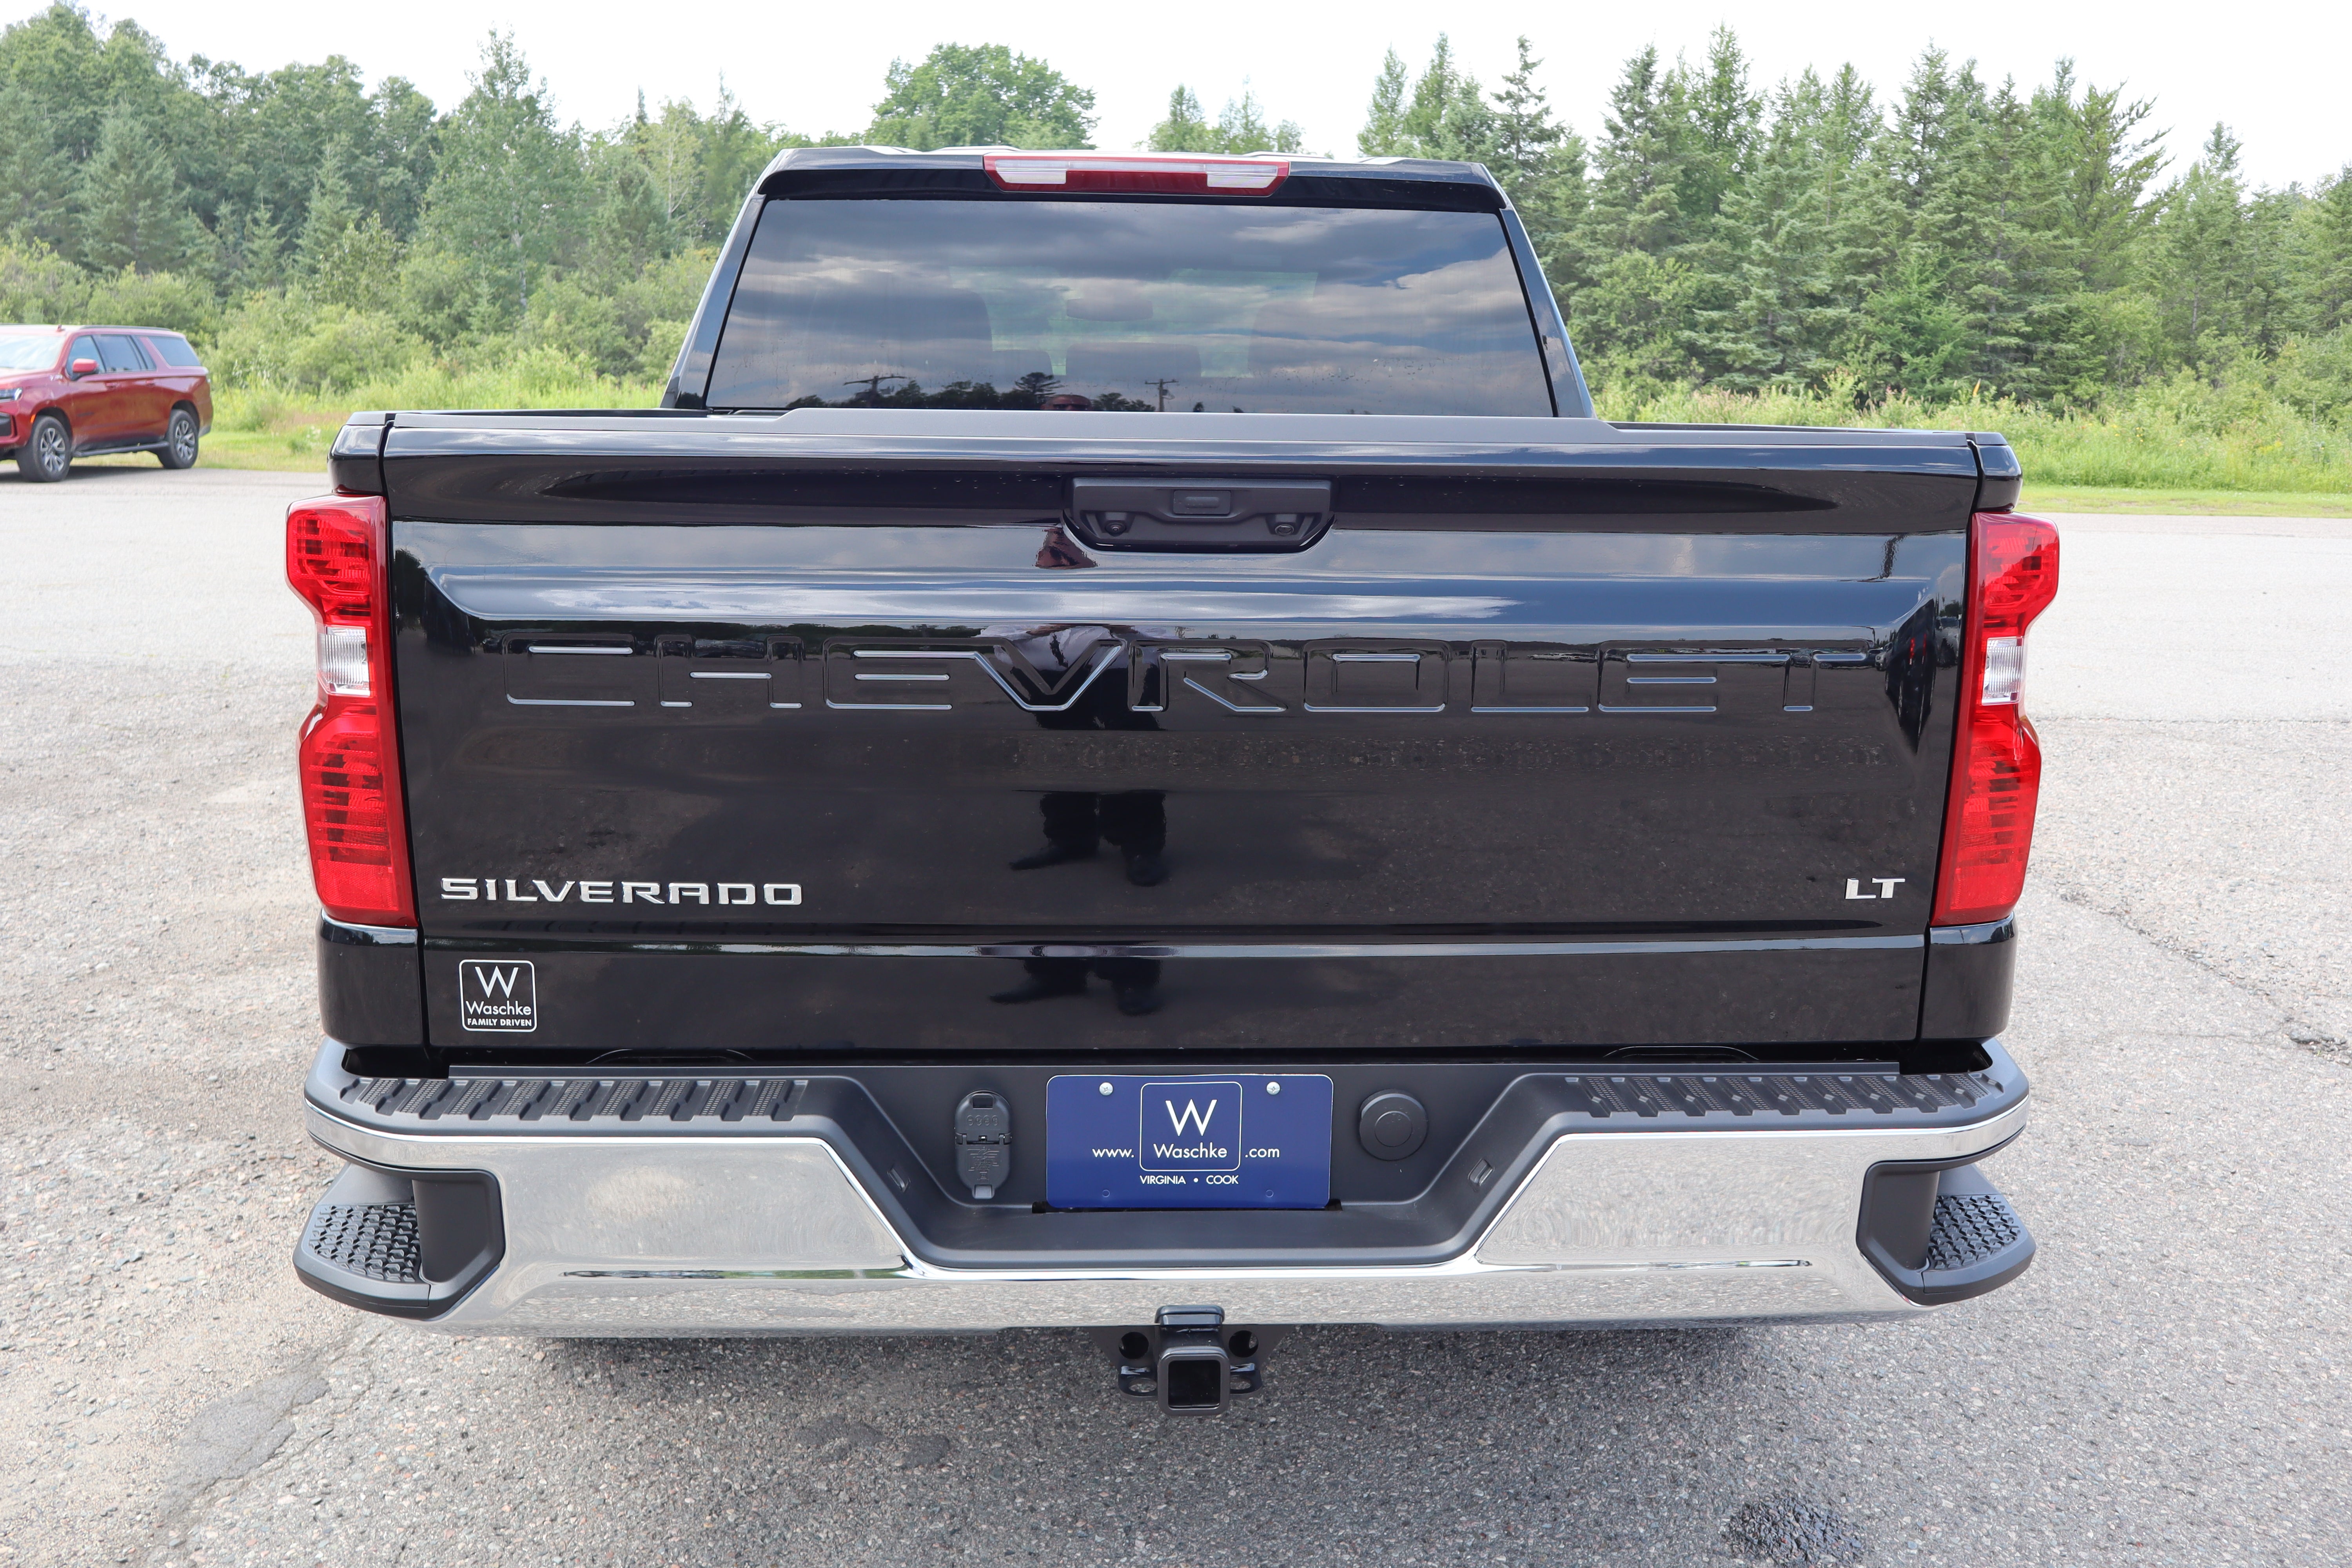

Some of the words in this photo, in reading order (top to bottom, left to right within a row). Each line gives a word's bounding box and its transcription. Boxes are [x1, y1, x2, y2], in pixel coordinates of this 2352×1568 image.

[503, 632, 1870, 713] CHEVROLET
[441, 878, 802, 905] SILVERADO
[1845, 878, 1906, 899] LT
[474, 965, 519, 999] W
[465, 1000, 532, 1015] Waschke
[1165, 1099, 1218, 1136] W
[1092, 1149, 1134, 1158] www.
[1153, 1142, 1227, 1158] Waschke
[1245, 1148, 1280, 1158] .com
[1140, 1175, 1186, 1185] VIRGINIA
[1206, 1175, 1239, 1185] COOK
